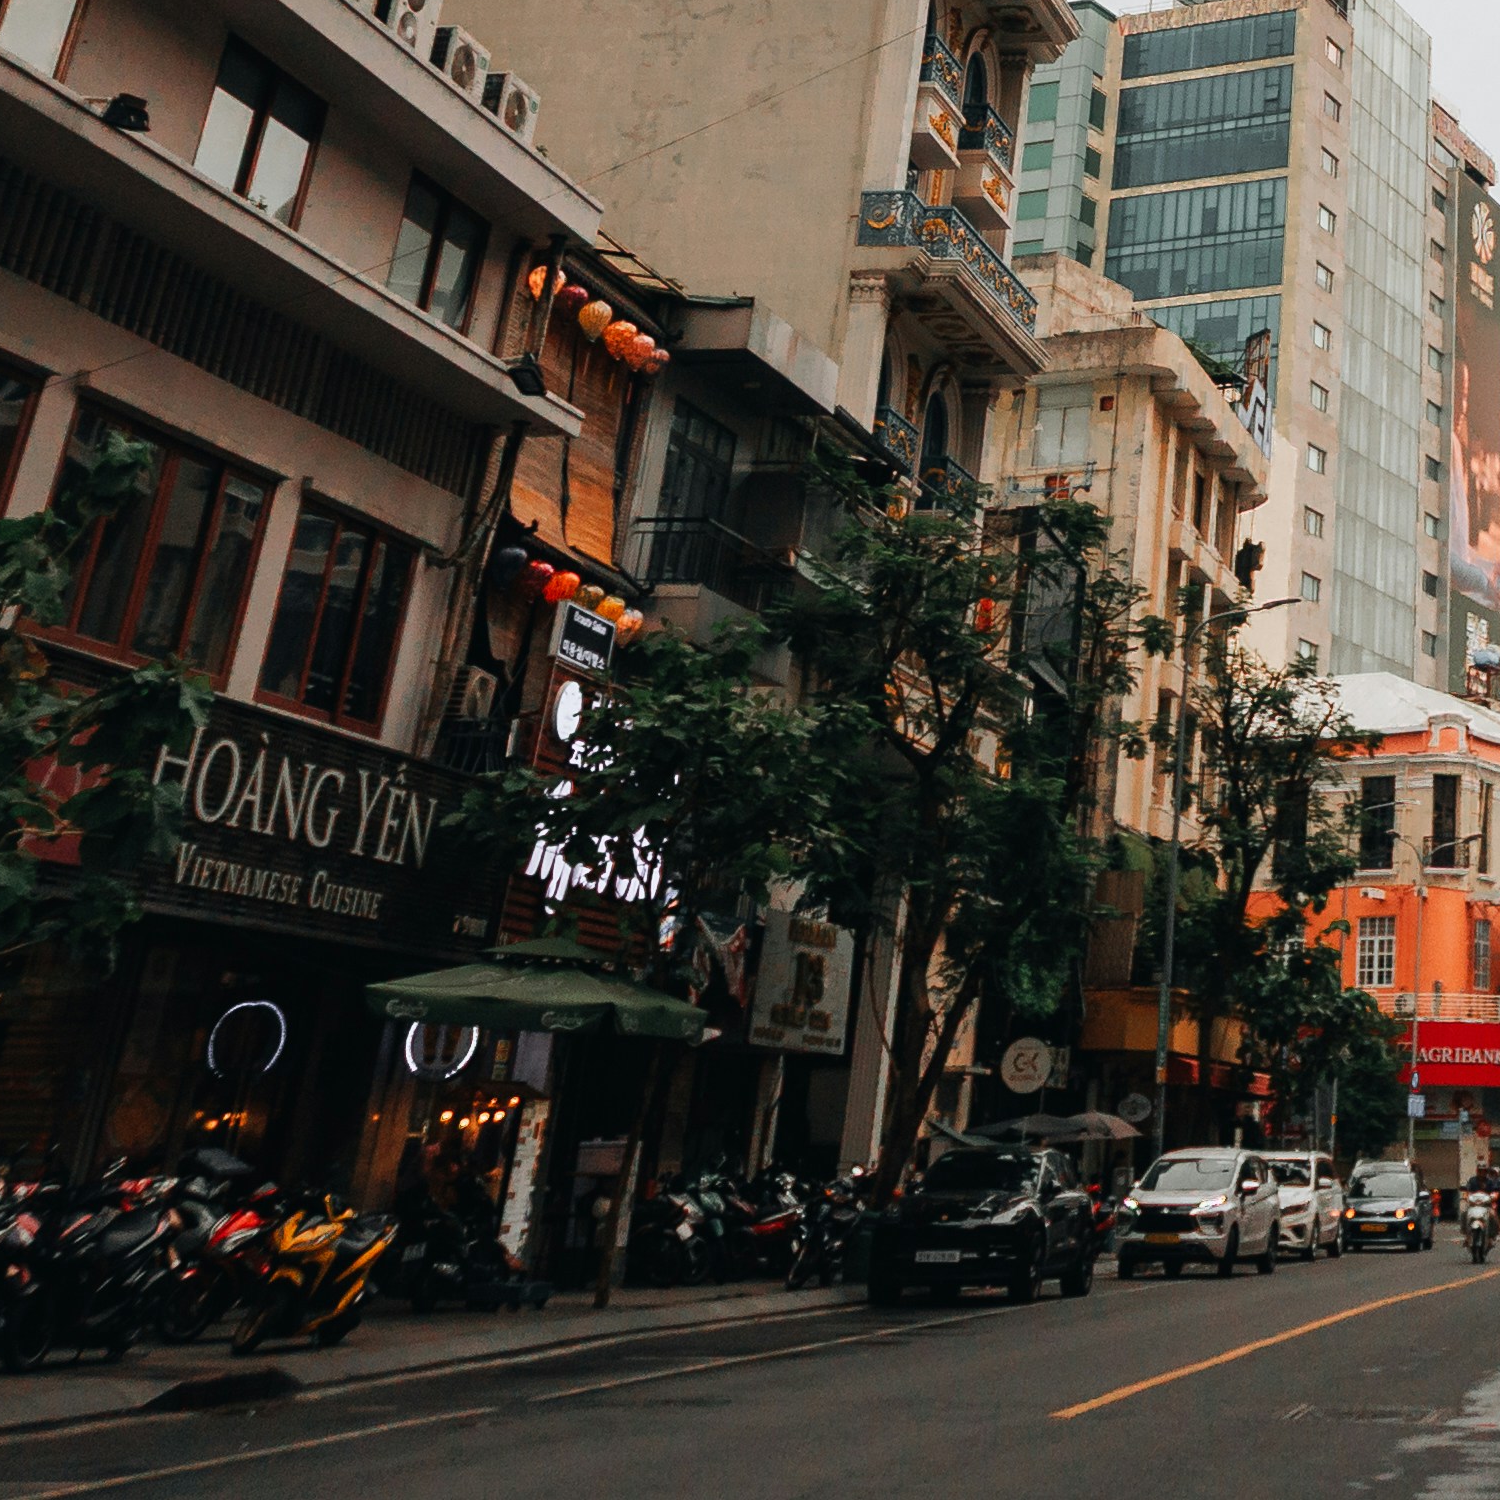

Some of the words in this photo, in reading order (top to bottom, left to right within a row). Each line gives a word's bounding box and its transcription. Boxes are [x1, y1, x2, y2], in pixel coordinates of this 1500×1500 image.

[152, 726, 346, 848] HOÀNG
[350, 762, 438, 869] YẾN
[176, 842, 302, 906] VIETNAMESE
[308, 870, 384, 920] CUISINE
